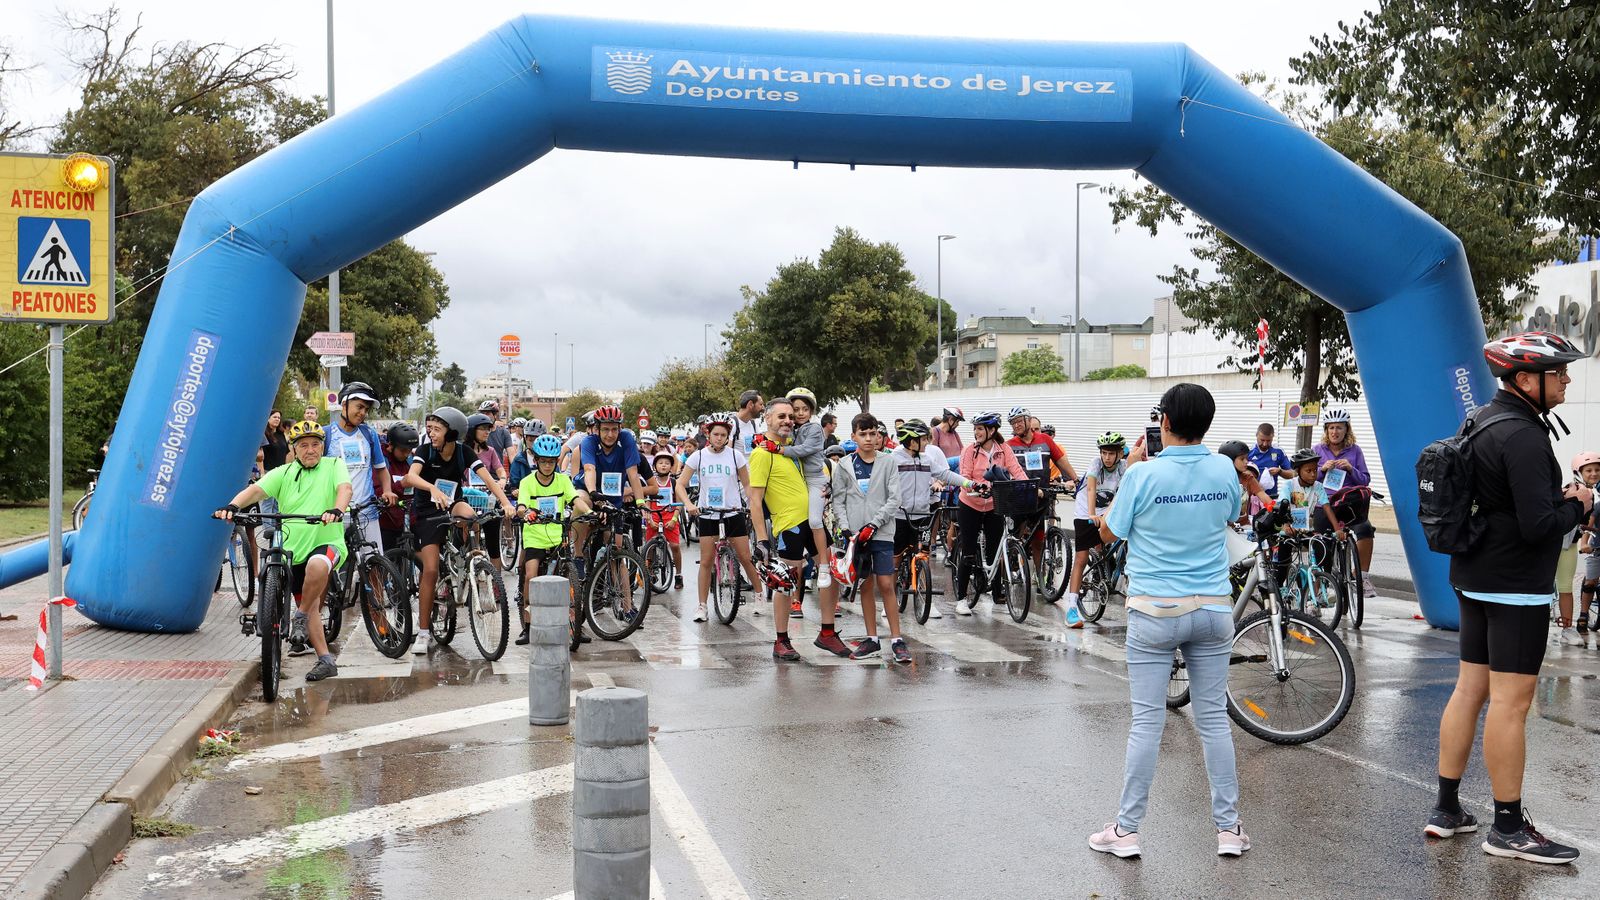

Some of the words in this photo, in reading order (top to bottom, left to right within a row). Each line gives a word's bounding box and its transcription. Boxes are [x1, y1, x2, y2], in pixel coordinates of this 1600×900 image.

[667, 59, 951, 89] Ayuntamiento
[962, 74, 1007, 91] de
[1018, 75, 1116, 96] Jerez
[666, 81, 799, 102] Deportes
[10, 189, 95, 211] ATENCION
[12, 291, 97, 314] PEATONES
[150, 336, 215, 503] deportes@aytojerez.es
[1154, 490, 1228, 504] ORGANIZACIÓN
